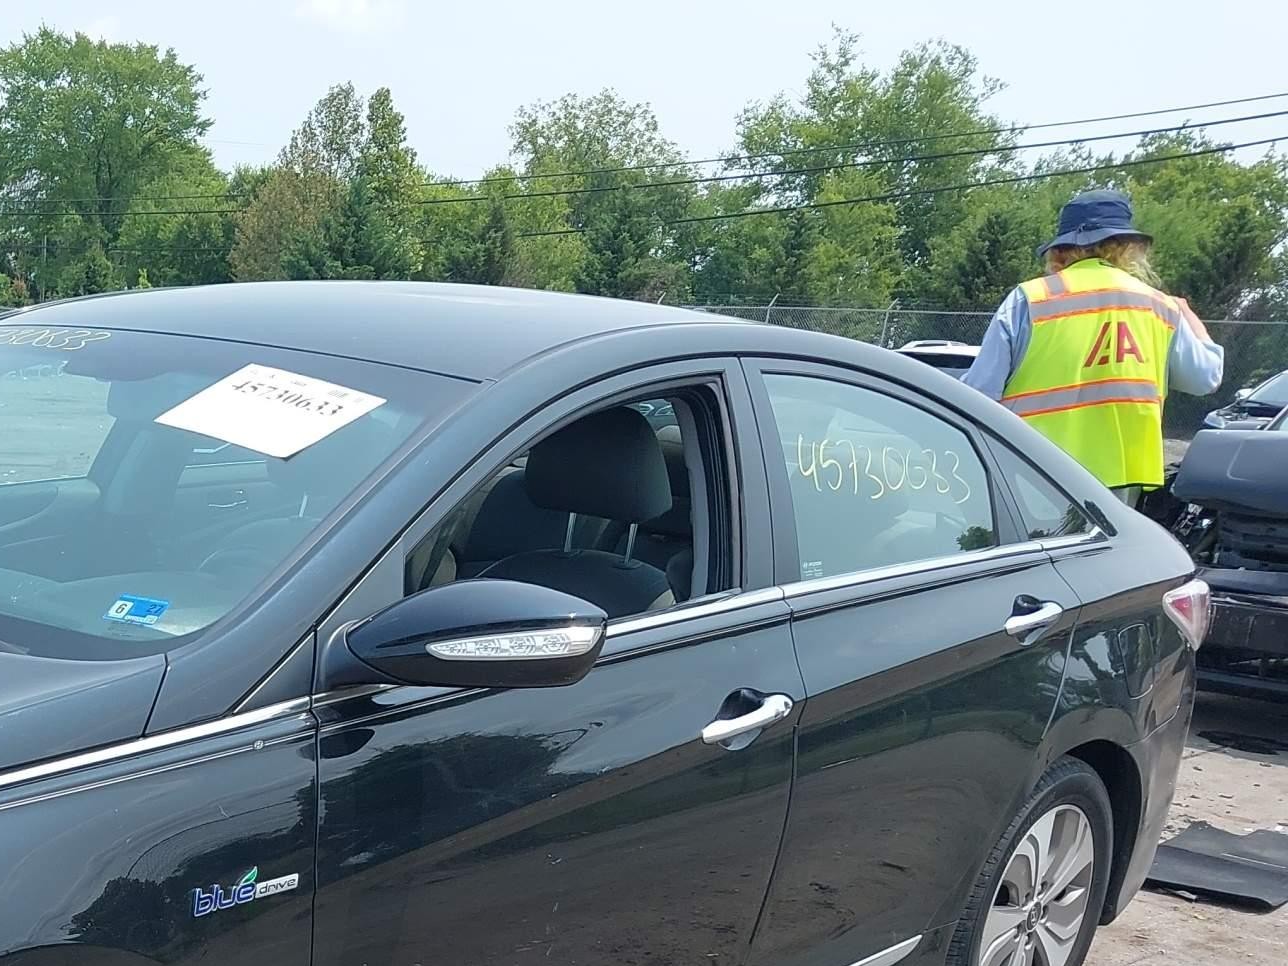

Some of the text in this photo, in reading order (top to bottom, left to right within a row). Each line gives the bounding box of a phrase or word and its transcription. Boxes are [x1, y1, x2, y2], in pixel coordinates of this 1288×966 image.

[231, 380, 345, 417] 45730633
[797, 433, 971, 504] 45730633
[115, 603, 165, 615] 6 27
[194, 879, 297, 917] blue drive
